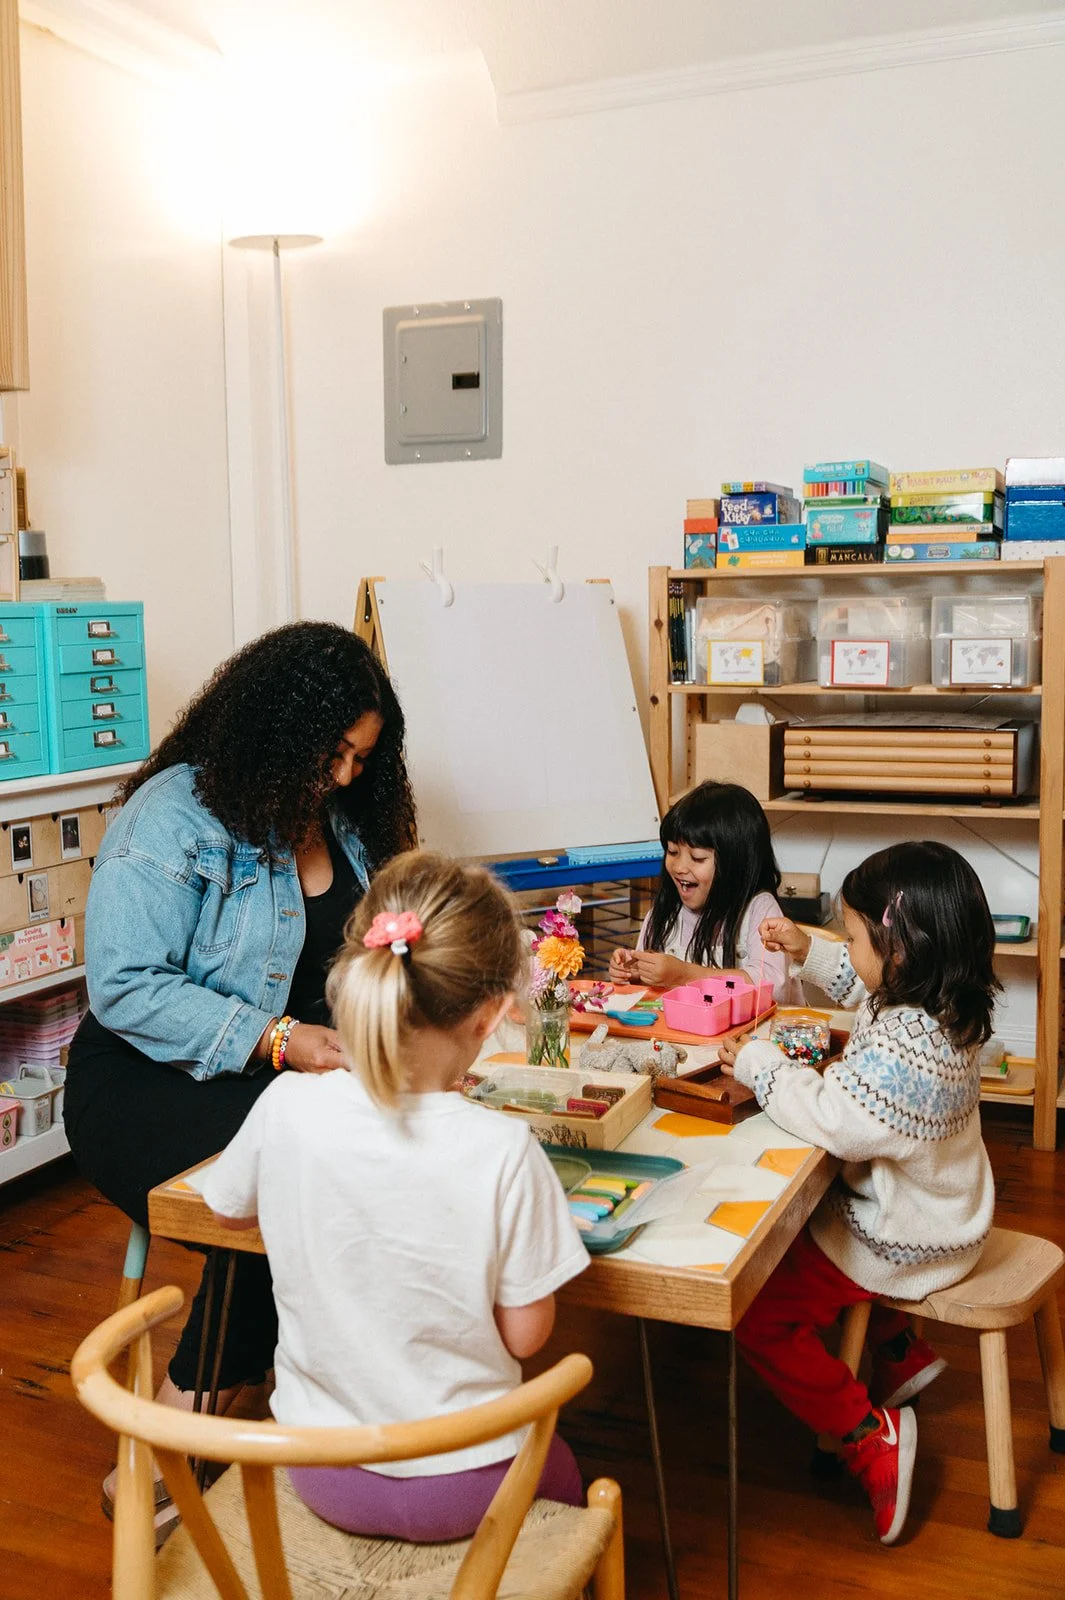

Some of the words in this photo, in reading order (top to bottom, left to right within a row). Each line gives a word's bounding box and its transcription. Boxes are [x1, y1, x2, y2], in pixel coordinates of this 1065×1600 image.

[721, 499, 748, 512] Feed
[723, 510, 751, 525] Kitty
[744, 529, 760, 537] CHA
[830, 553, 875, 561] MANCALA
